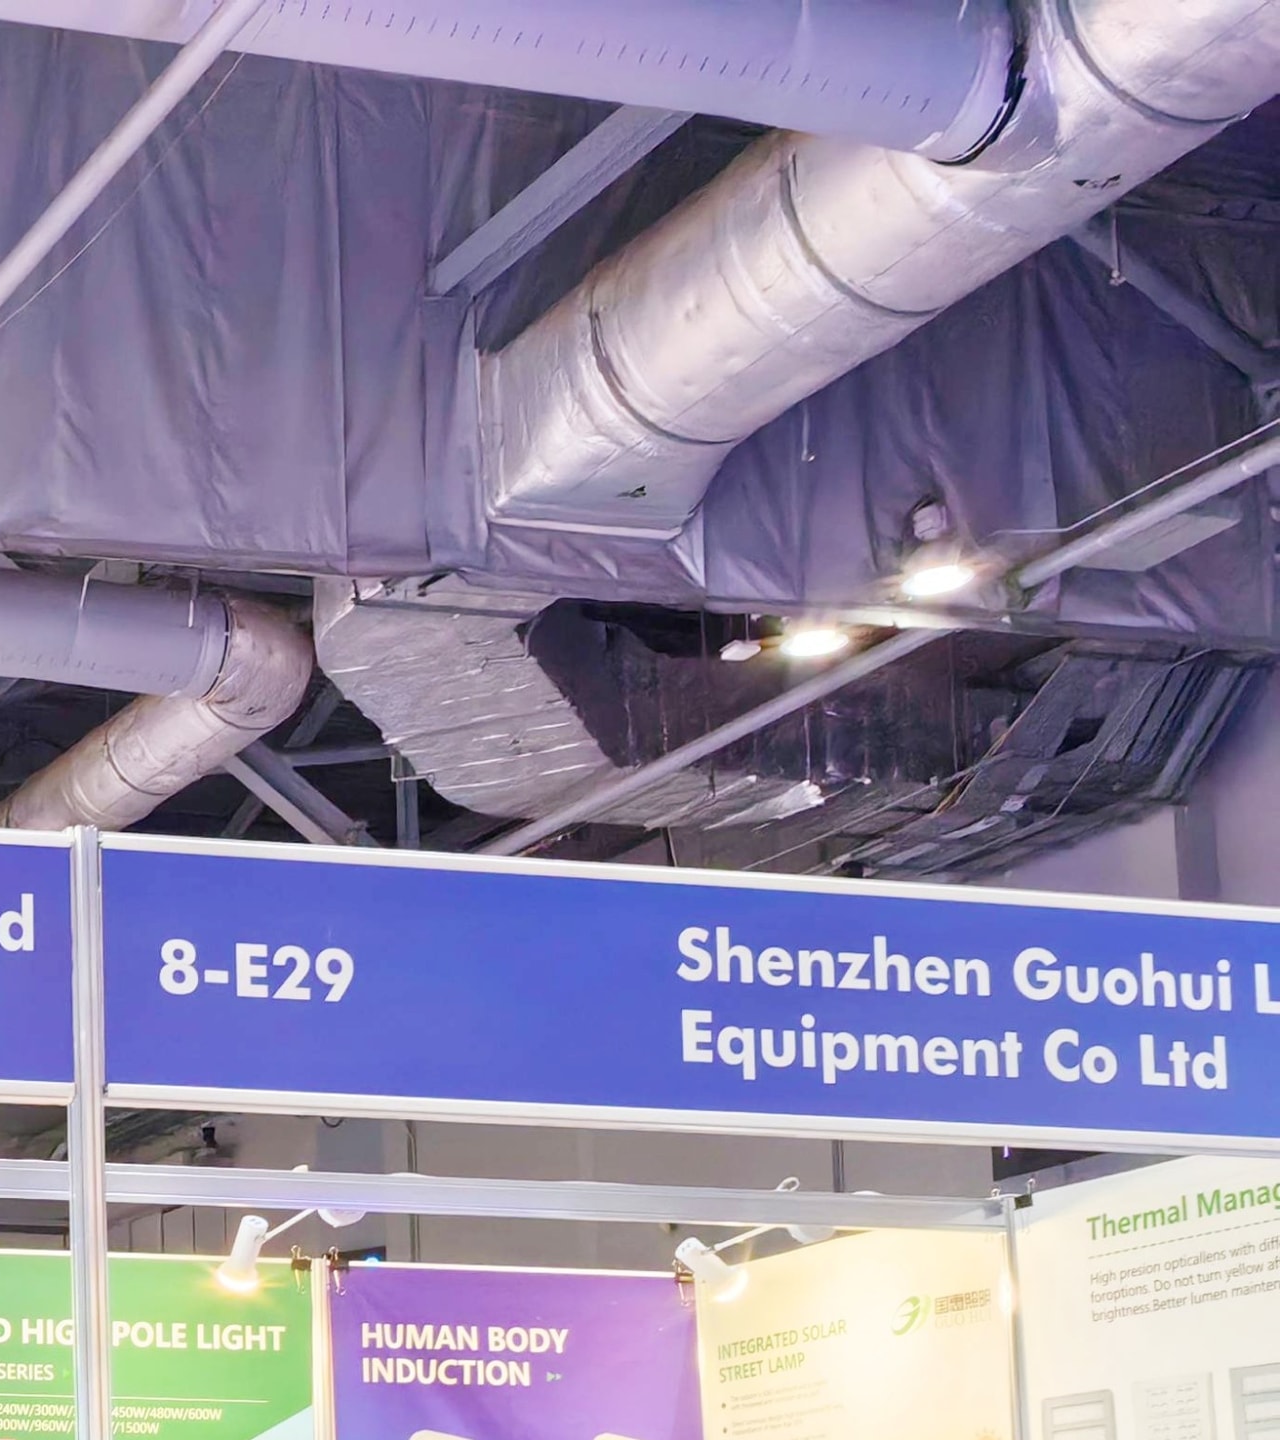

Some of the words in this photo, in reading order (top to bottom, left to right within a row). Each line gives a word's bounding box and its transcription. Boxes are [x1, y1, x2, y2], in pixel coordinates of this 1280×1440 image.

[159, 939, 354, 1003] 8-E29
[677, 927, 990, 996] Shenzhen
[1013, 947, 1232, 1012] Guohui
[681, 1009, 1022, 1084] Equipment
[1043, 1028, 1117, 1085] Co
[1140, 1034, 1228, 1090] Ltd
[1087, 1195, 1188, 1241] Thermal
[1090, 1267, 1117, 1286] High
[1230, 1242, 1256, 1258] with
[1154, 1279, 1171, 1292] Do
[1174, 1274, 1194, 1289] not
[1197, 1270, 1222, 1284] turn
[1225, 1262, 1264, 1283] yellow
[1191, 1288, 1228, 1305] lumen
[22, 1318, 75, 1345] HIG
[112, 1321, 188, 1349] POLE
[197, 1323, 286, 1351] LIGHT
[361, 1322, 478, 1351] HUMAN
[488, 1326, 569, 1354] BODY
[717, 1325, 799, 1361] INTEGRATED
[802, 1318, 847, 1343] SOLAR
[362, 1357, 531, 1386] INDUCTION
[718, 1359, 763, 1384] STREET
[768, 1351, 805, 1375] LAMP
